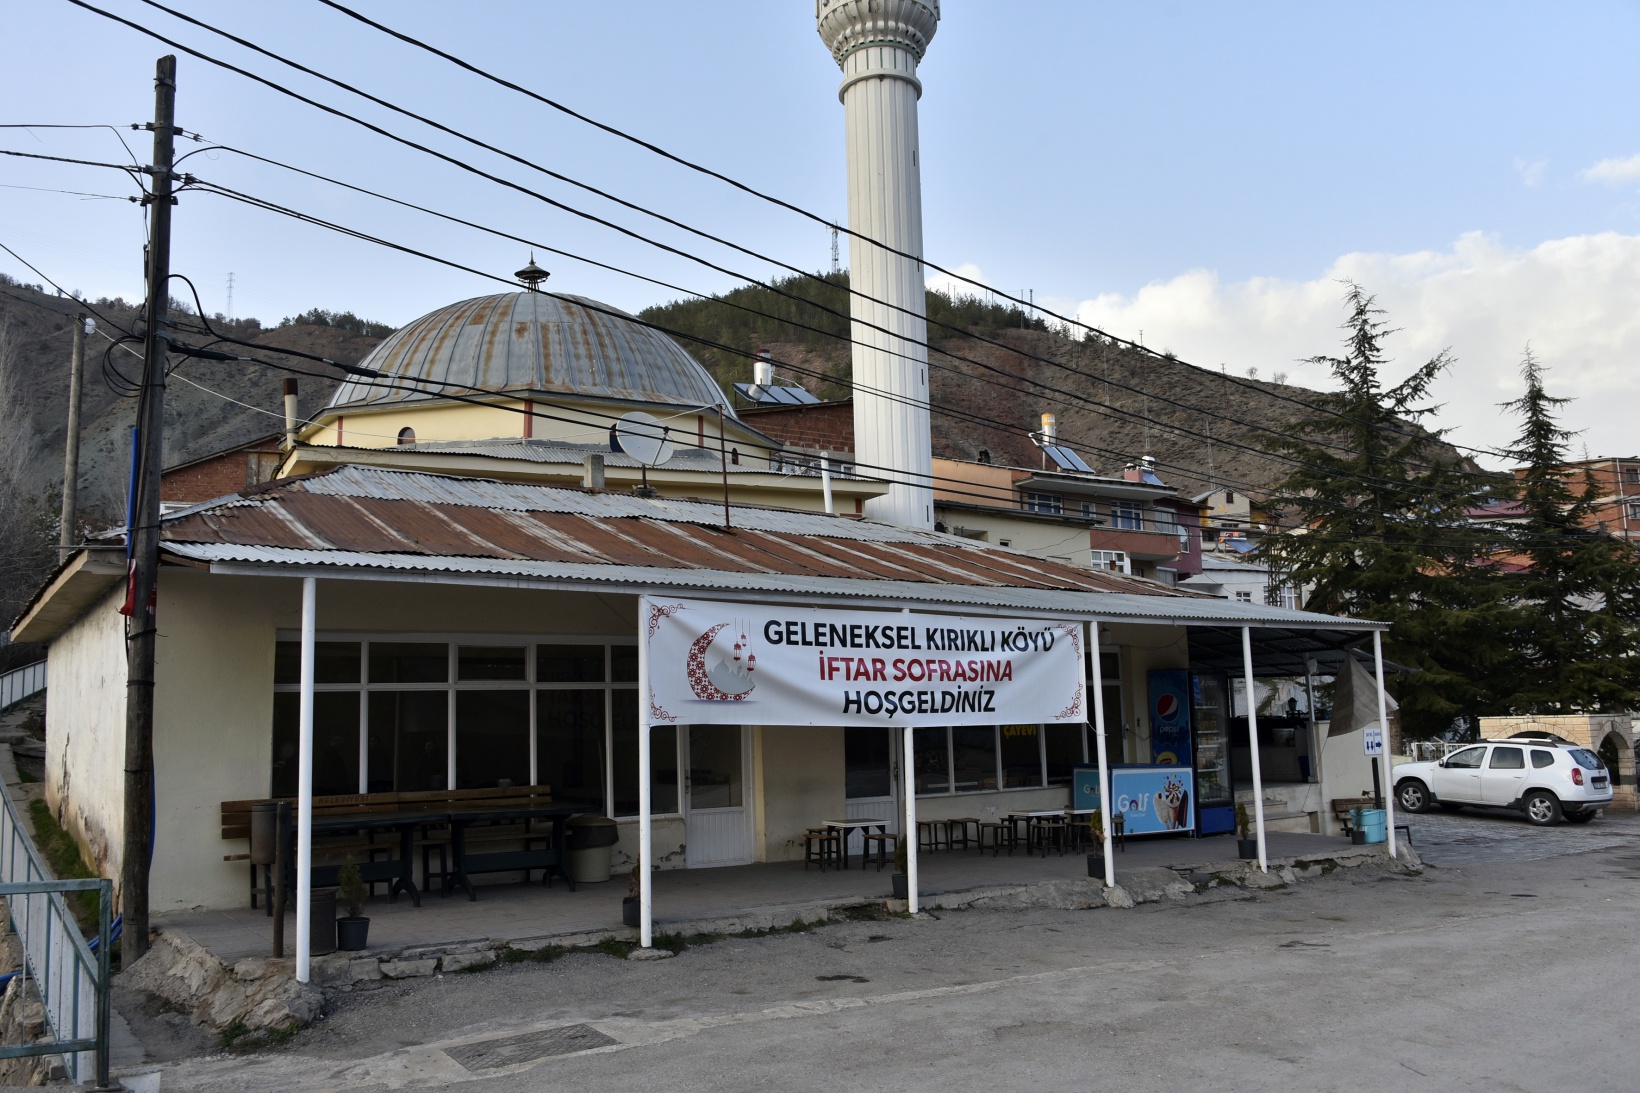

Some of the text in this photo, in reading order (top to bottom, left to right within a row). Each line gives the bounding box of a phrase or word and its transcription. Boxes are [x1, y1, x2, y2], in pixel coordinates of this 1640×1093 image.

[764, 620, 1055, 652] GELENEKSEL KIRIKLI KÖYÜ
[819, 650, 1013, 682] İFTAR SOFRASINA
[843, 685, 996, 719] HOŞGELDİNİZ
[1160, 725, 1179, 734] pepsi
[1118, 792, 1150, 813] Golf
